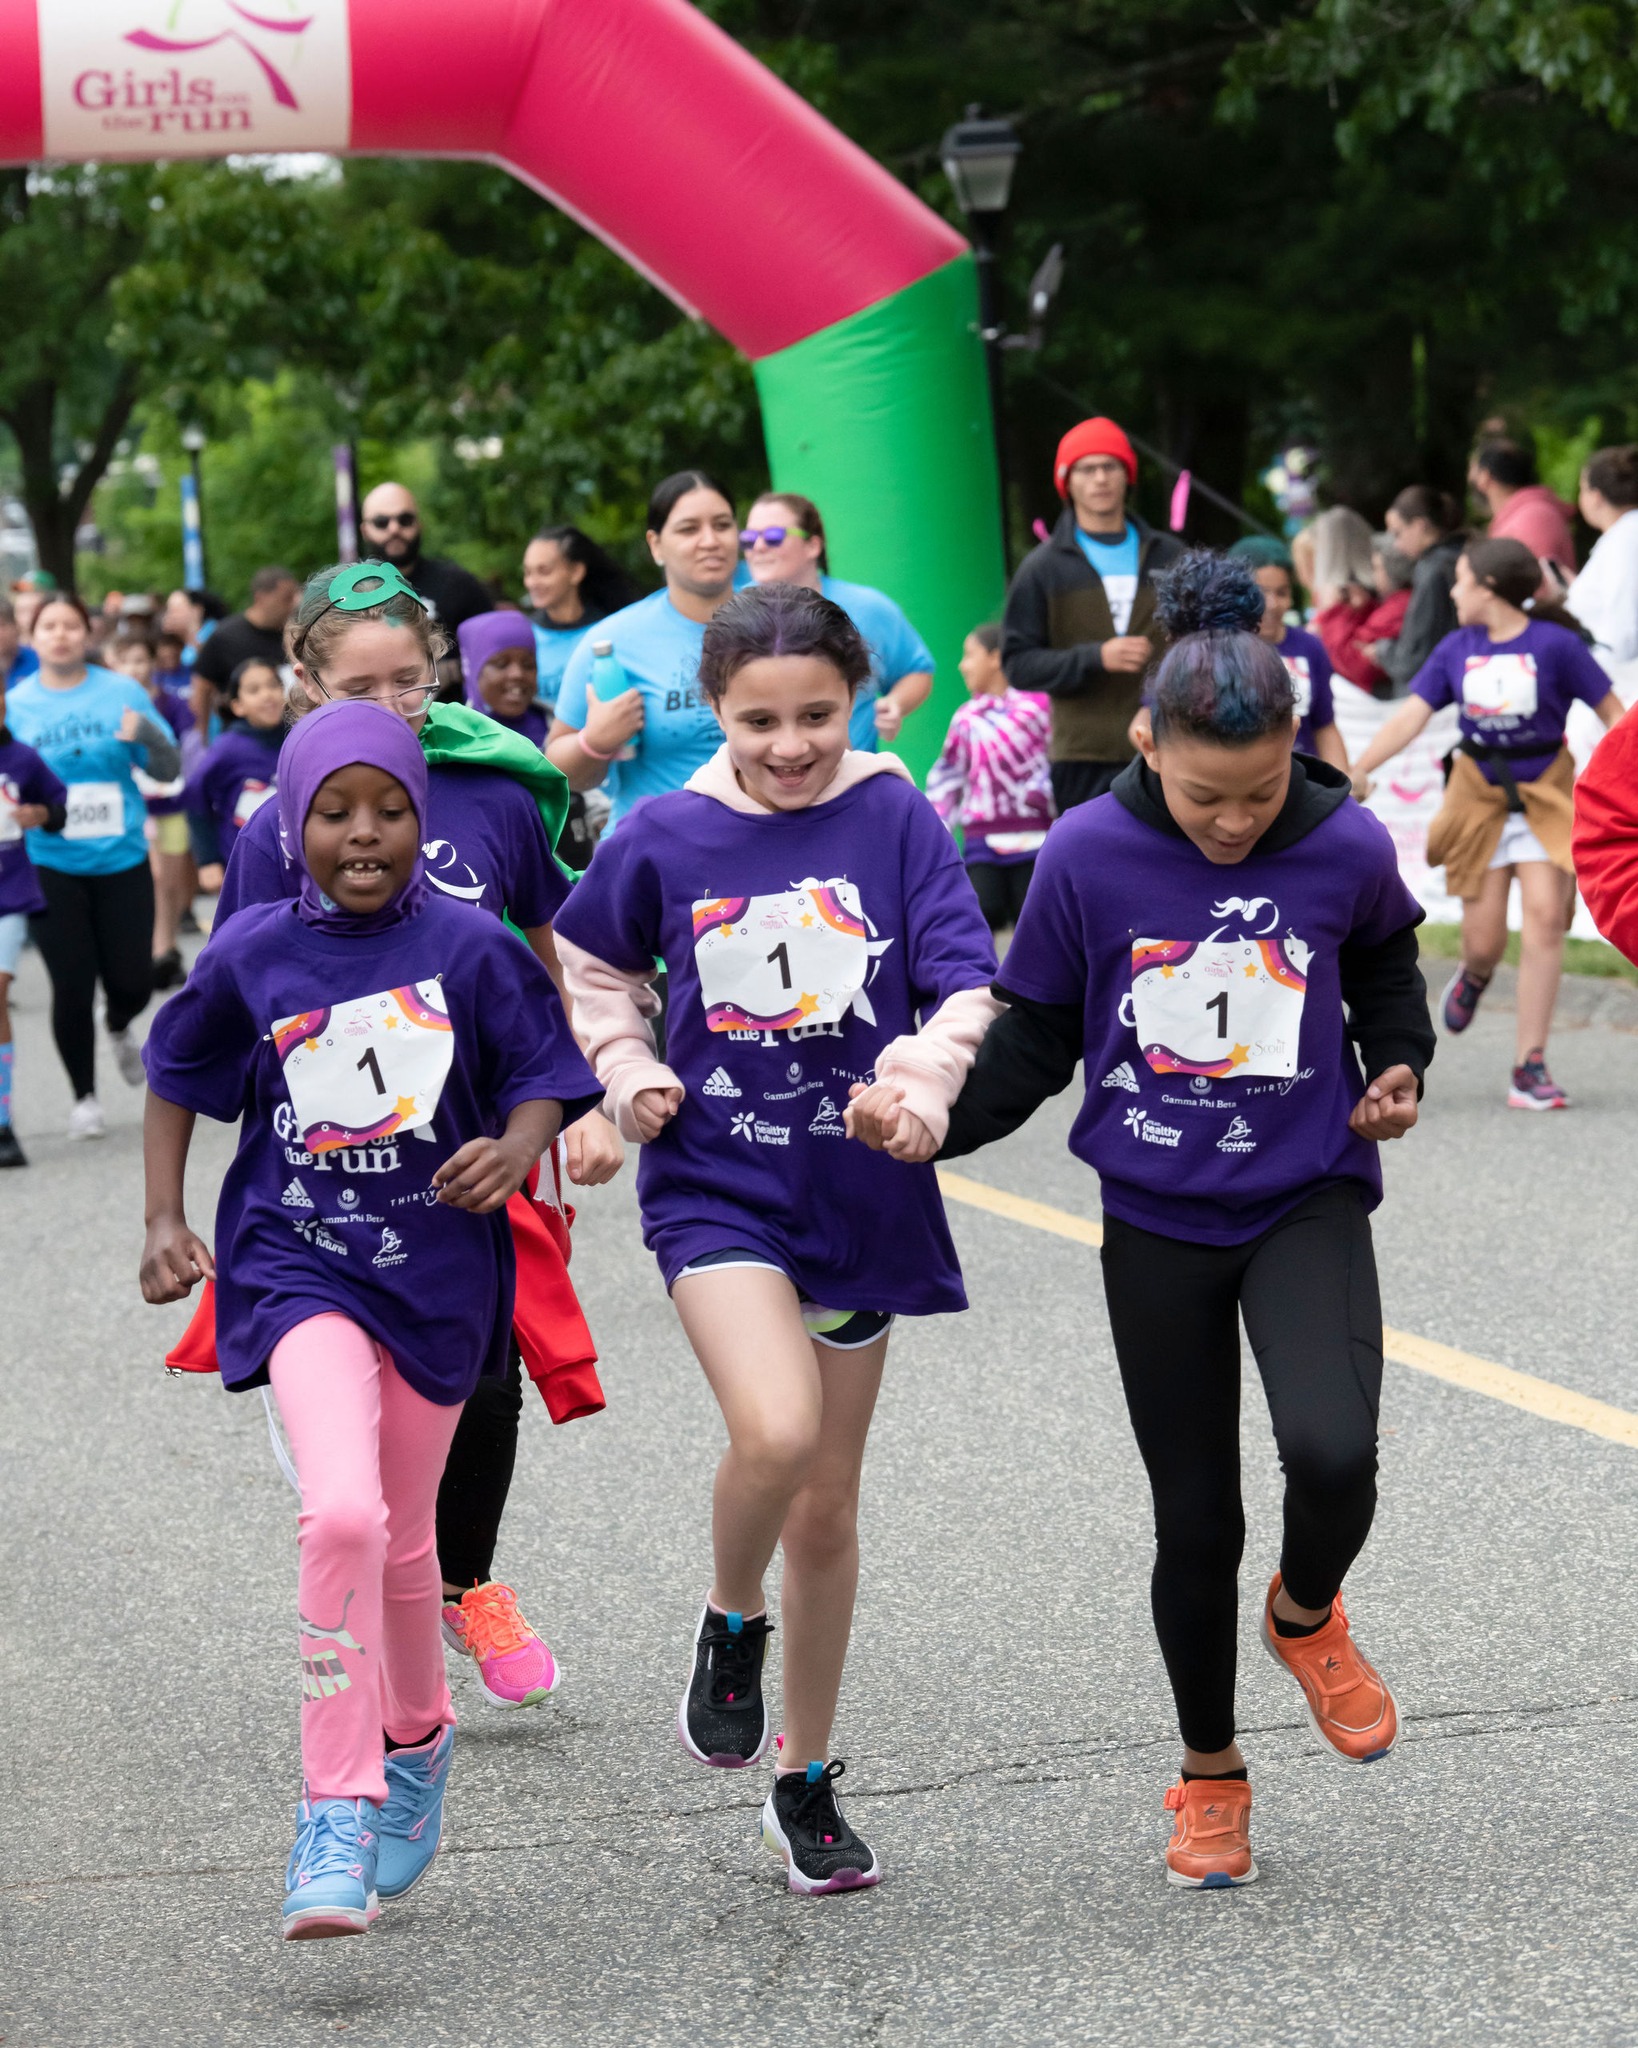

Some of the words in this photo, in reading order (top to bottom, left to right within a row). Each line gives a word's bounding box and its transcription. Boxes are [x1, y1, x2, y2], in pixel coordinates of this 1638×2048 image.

[72, 68, 214, 111] Girls
[151, 109, 253, 133] run
[767, 942, 792, 990] 1
[1206, 991, 1228, 1039] 1
[357, 1046, 387, 1096] 1
[702, 1083, 742, 1097] adidas
[1101, 1075, 1140, 1094] adidas
[763, 1090, 797, 1101] Gamma
[1161, 1094, 1198, 1106] Gamma
[1199, 1098, 1215, 1108] Phi
[1216, 1099, 1237, 1109] Beta
[754, 1122, 790, 1138] healthy
[755, 1132, 789, 1146] futures
[1142, 1121, 1182, 1140] healthy
[1142, 1131, 1179, 1148] futures
[1216, 1139, 1257, 1149] Caribou
[313, 1146, 402, 1174] run
[390, 1189, 436, 1207] THIRTY
[349, 1214, 364, 1223] Phi
[366, 1214, 385, 1223] Beta
[315, 1235, 349, 1256] futures
